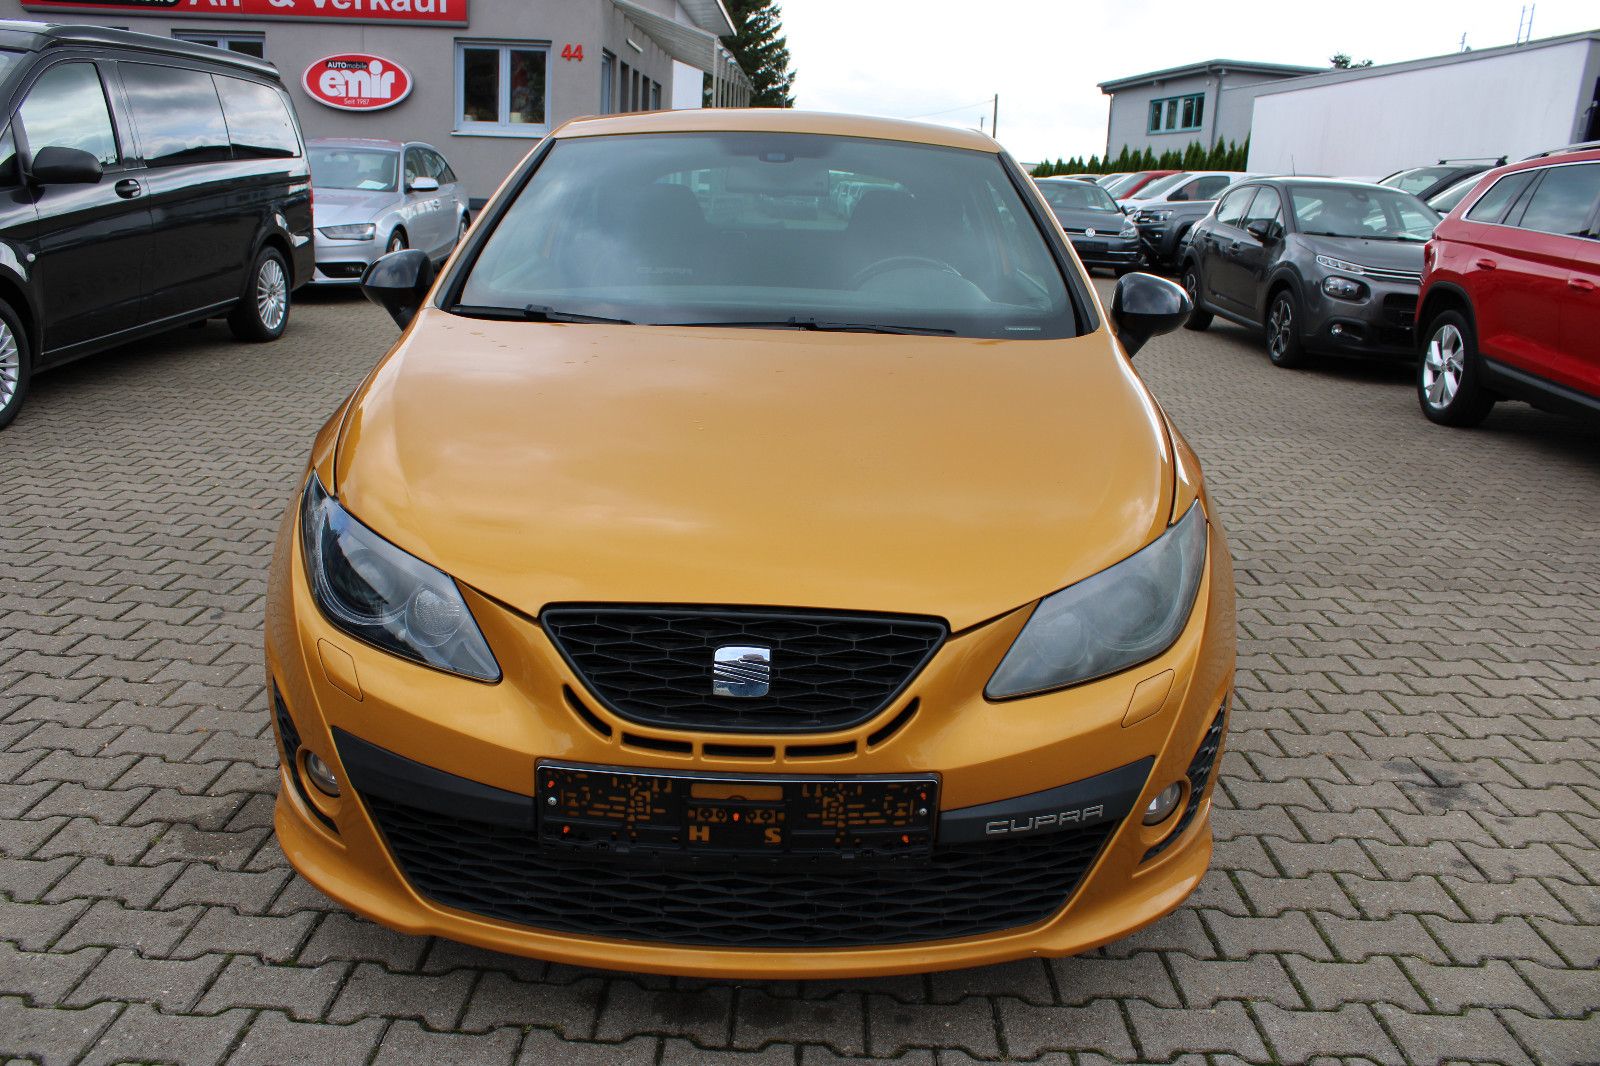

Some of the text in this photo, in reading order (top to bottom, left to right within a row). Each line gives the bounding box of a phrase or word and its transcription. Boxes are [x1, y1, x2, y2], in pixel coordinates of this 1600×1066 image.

[561, 43, 584, 61] 44
[327, 61, 368, 70] AUTOmobile
[319, 60, 395, 98] emir
[986, 804, 1104, 835] CUPRA
